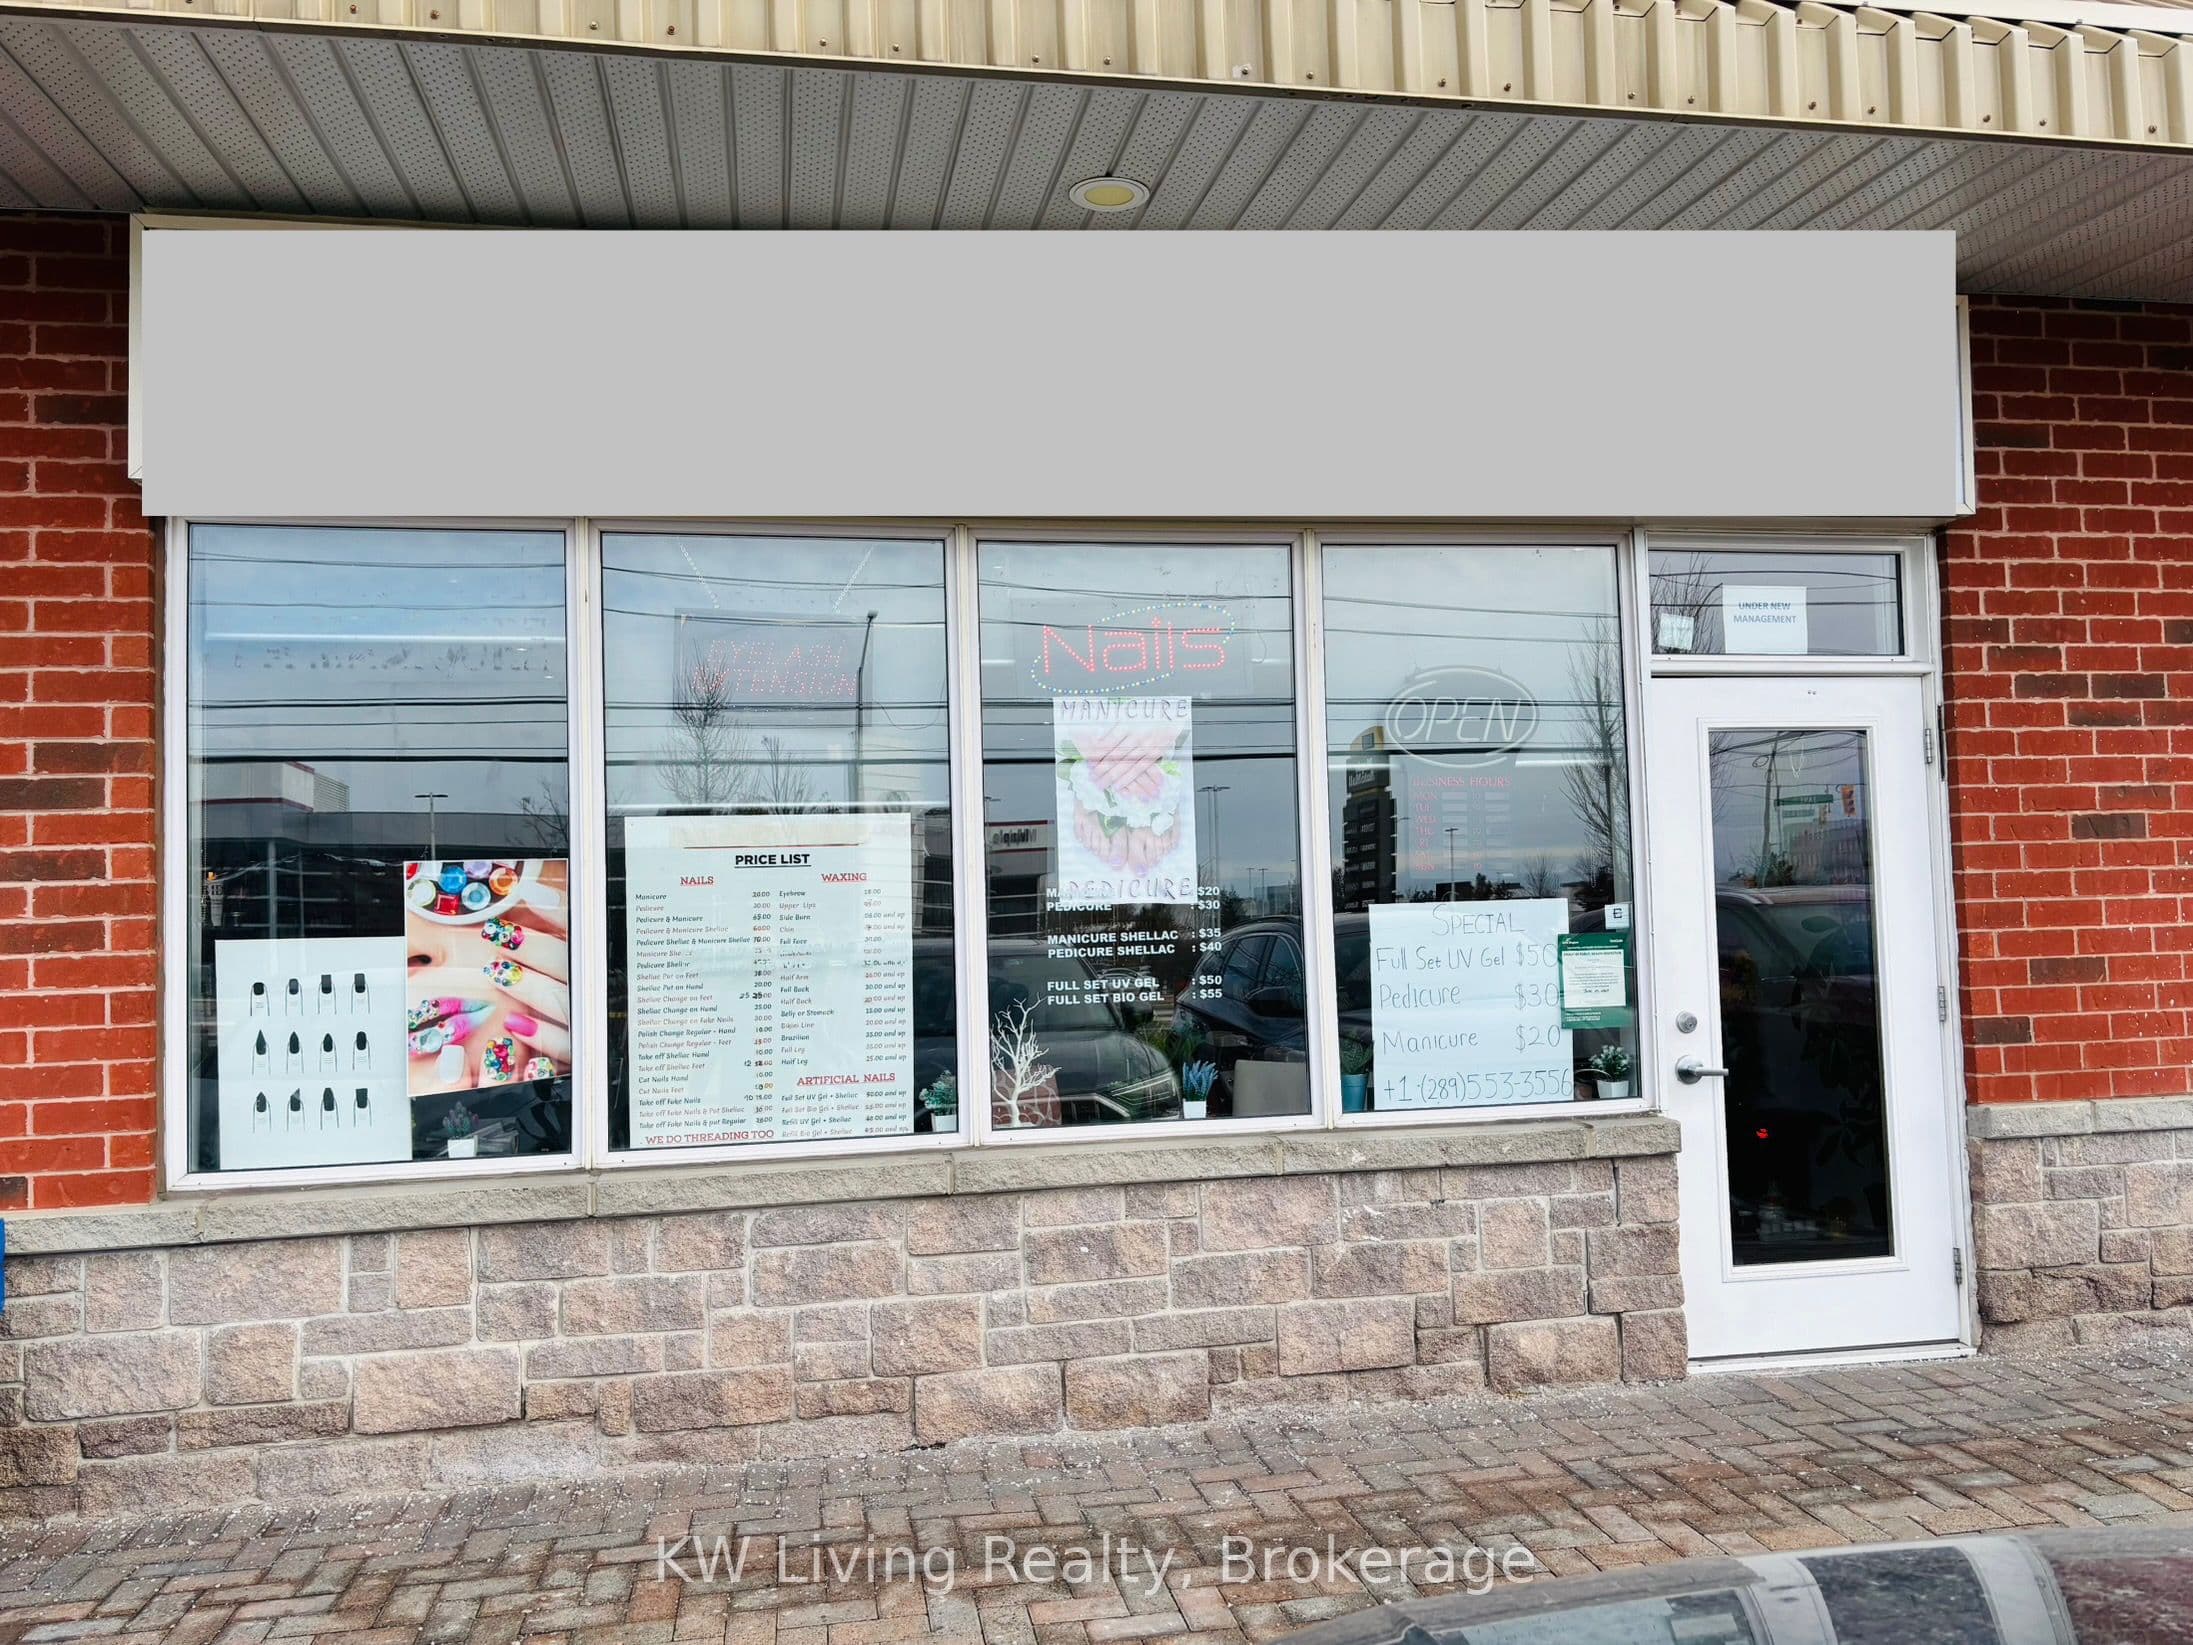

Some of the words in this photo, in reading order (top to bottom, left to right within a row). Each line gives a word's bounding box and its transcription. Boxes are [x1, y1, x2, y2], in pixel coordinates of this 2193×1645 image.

[1770, 602, 1790, 610] NEW
[1042, 616, 1225, 673] Nails
[1062, 700, 1188, 720] MANICURE
[1396, 697, 1521, 742] OPEN
[736, 855, 777, 866] PRICE
[781, 853, 810, 864] LIST
[680, 876, 714, 885] NAILS
[821, 873, 867, 881] WAXING
[1069, 878, 1192, 899] PEDICURE
[1198, 887, 1220, 896] $20
[1198, 901, 1220, 910] $30
[1613, 908, 1622, 919] E
[1432, 903, 1525, 936] SPECIAL
[1048, 933, 1116, 944] MANICURE
[1120, 931, 1178, 942] SHELLAC
[1199, 928, 1221, 938] $35
[1048, 947, 1113, 958] PEDICURE
[1117, 944, 1175, 955] SHELLAC
[1199, 942, 1222, 952] $40
[1376, 947, 1407, 971] Full
[1416, 946, 1441, 970] Set
[1450, 946, 1472, 969] UV
[1481, 946, 1504, 967] Gel
[1516, 943, 1558, 969] $50
[1048, 981, 1080, 991] FULL
[1084, 979, 1108, 989] SET
[1112, 979, 1131, 988] UV
[1135, 977, 1159, 987] GEL
[1199, 975, 1222, 986] $50
[1048, 995, 1080, 1005] FULL
[1084, 994, 1108, 1004] SET
[1113, 993, 1135, 1002] BIO
[1139, 992, 1164, 1001] GEL
[1200, 989, 1222, 999] $55
[1379, 984, 1461, 1009] Pedicure
[1515, 983, 1559, 1010] $30
[1383, 1030, 1478, 1055] Manicure
[1516, 1025, 1561, 1052] $20
[797, 1075, 859, 1086] ARTIFICIAL
[864, 1073, 895, 1082] NAILS
[646, 1136, 663, 1144] WE
[666, 1135, 680, 1143] DO
[685, 1132, 749, 1142] THREADING
[751, 1130, 774, 1138] TOO
